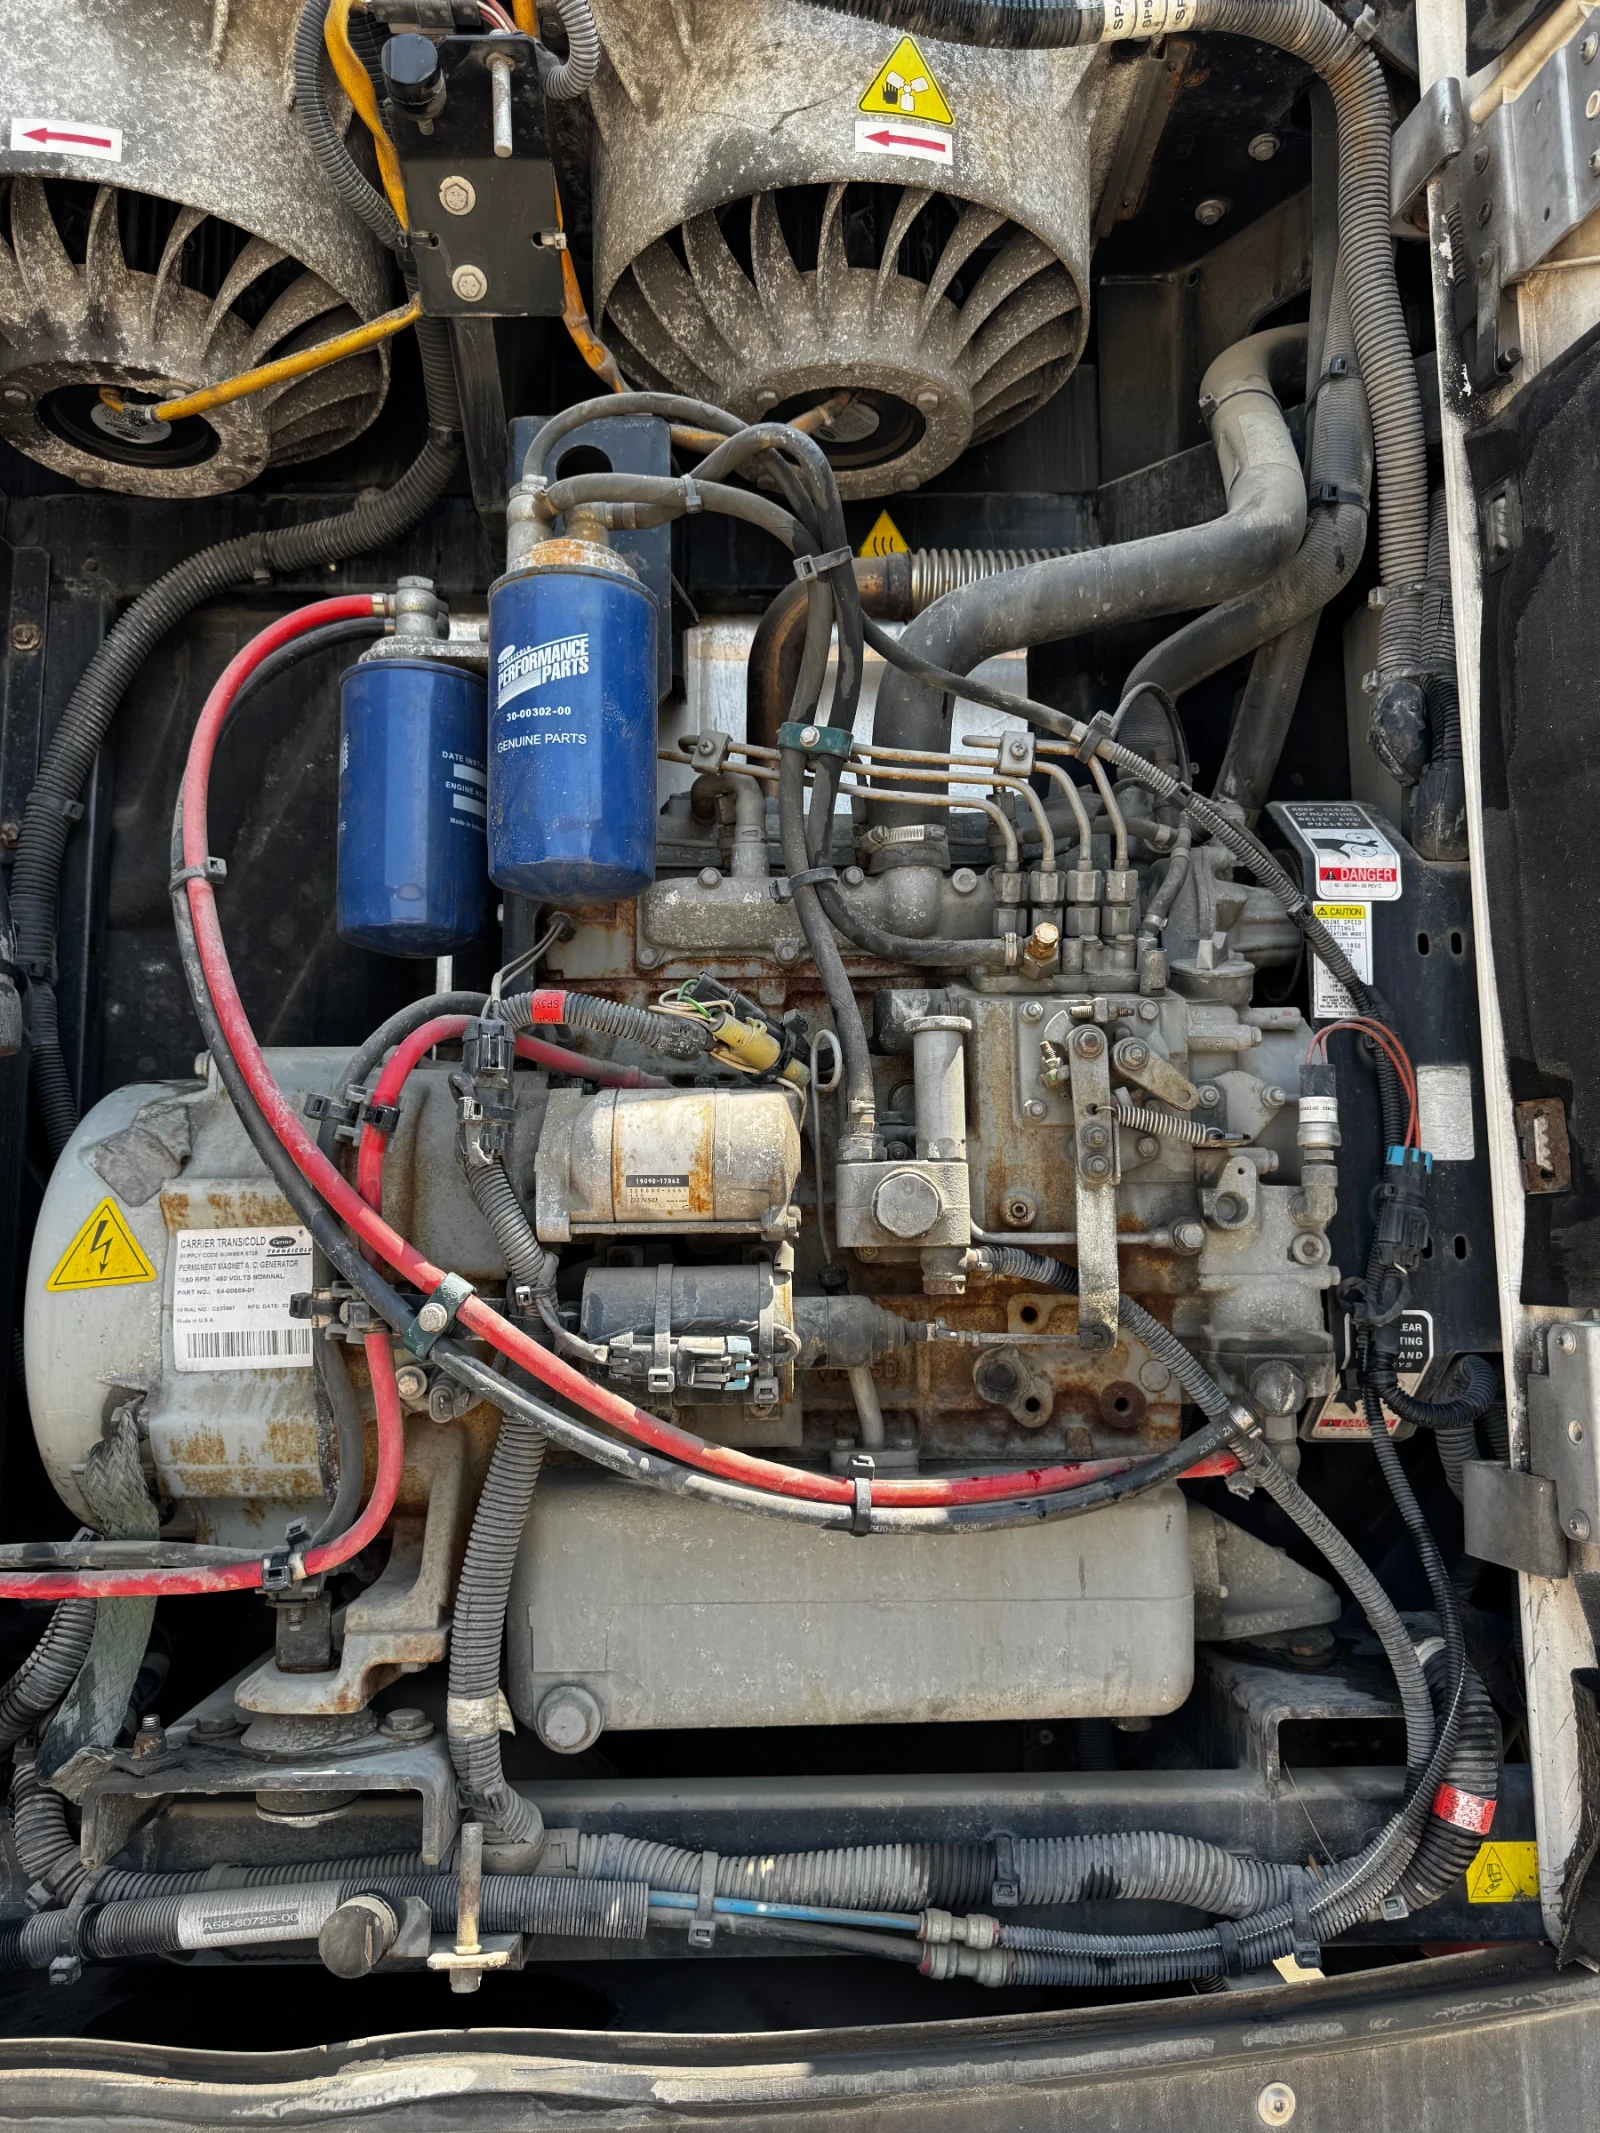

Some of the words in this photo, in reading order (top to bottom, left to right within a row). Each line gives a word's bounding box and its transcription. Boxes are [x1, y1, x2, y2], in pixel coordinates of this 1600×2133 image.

[498, 638, 588, 691] PERFORMANCE
[542, 656, 588, 684] PARTS
[506, 706, 572, 722] 30-00302-00
[498, 734, 541, 753] GENUINE
[544, 733, 586, 744] PARTS
[442, 750, 464, 763] DATE
[445, 781, 474, 795] ENGINE
[1340, 869, 1392, 880] DANGER
[181, 1238, 215, 1248] CARRIER
[218, 1237, 266, 1247] TRANSICOLD
[179, 1263, 216, 1271] PERMANENT
[261, 1260, 298, 1268] GENERATOR
[1398, 1352, 1423, 1360] AND
[202, 1912, 298, 1931] A58-60725-00
